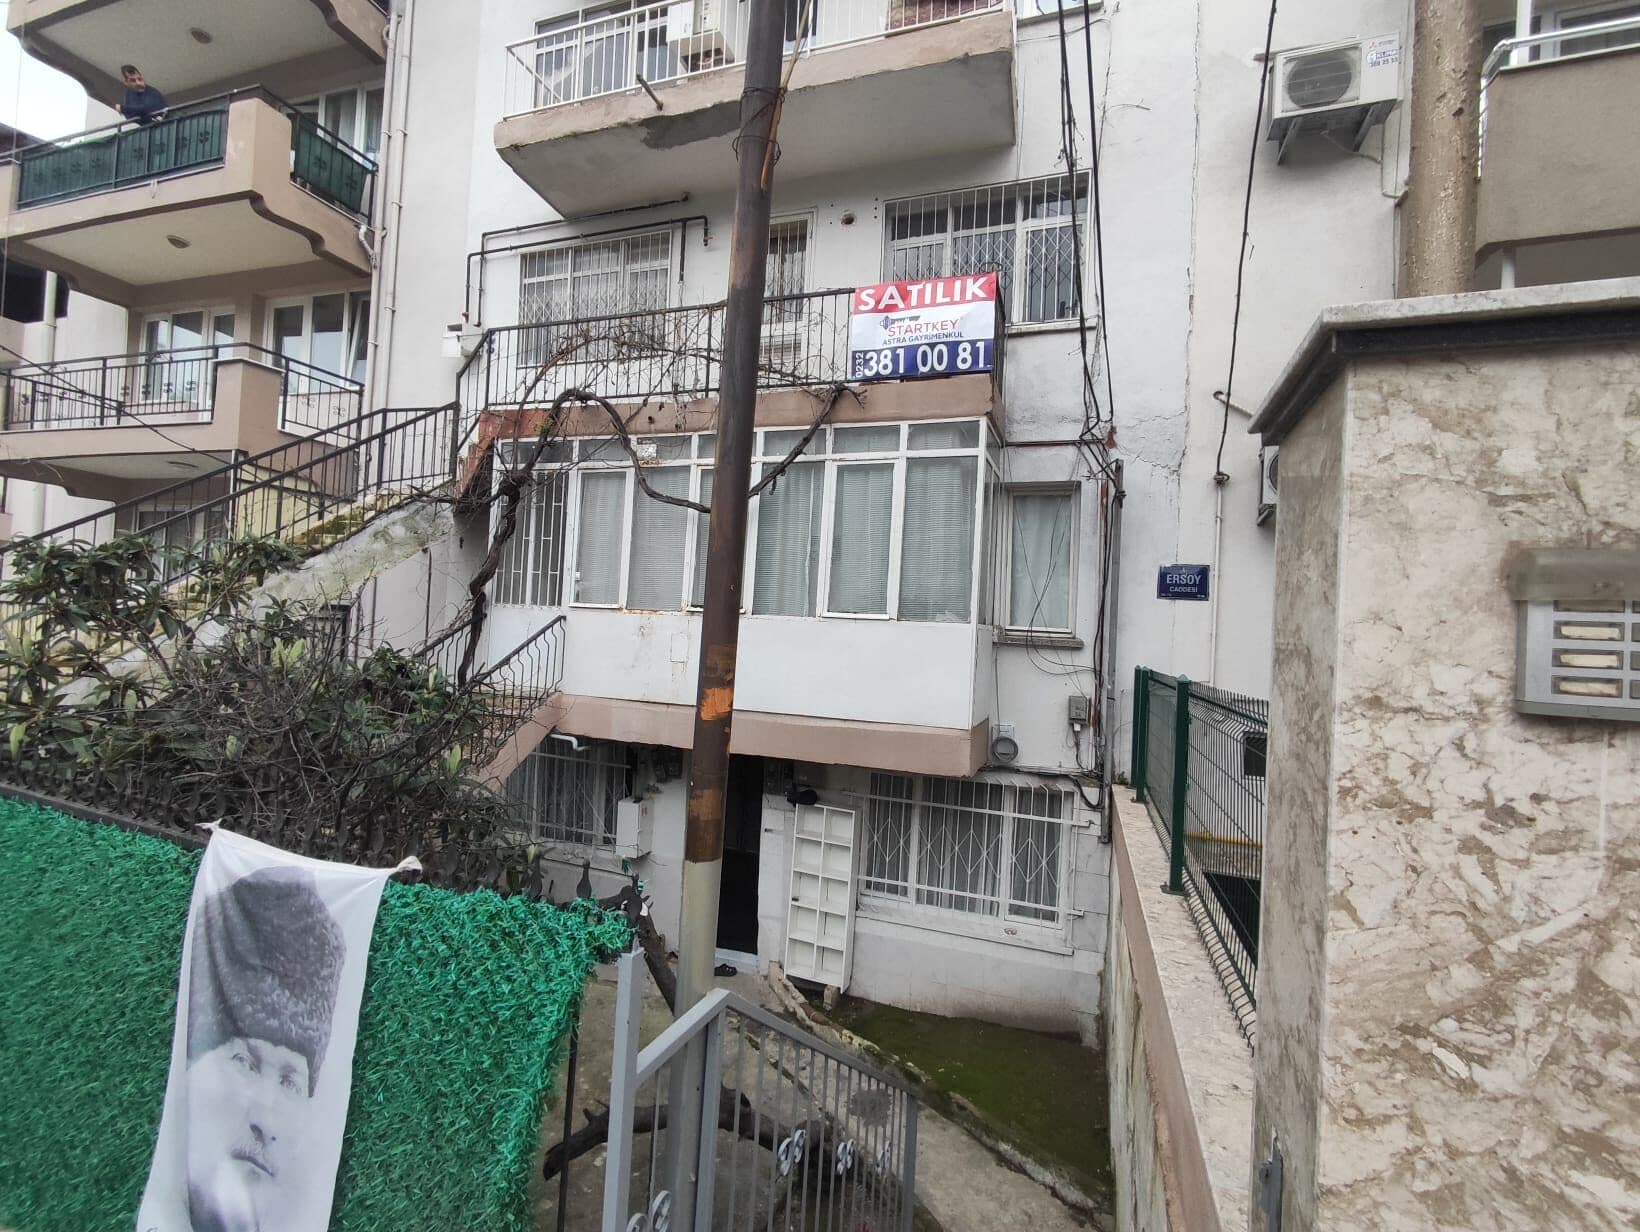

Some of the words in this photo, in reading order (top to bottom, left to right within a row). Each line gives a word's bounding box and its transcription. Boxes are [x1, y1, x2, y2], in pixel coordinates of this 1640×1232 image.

[858, 276, 988, 311] SATILIK
[888, 319, 958, 337] STARTKEY
[883, 337, 907, 346] ASTRA
[855, 351, 864, 378] 0232
[864, 347, 905, 377] 381
[916, 343, 949, 373] 00
[956, 341, 985, 370] 81
[1166, 574, 1201, 585] ERSOY
